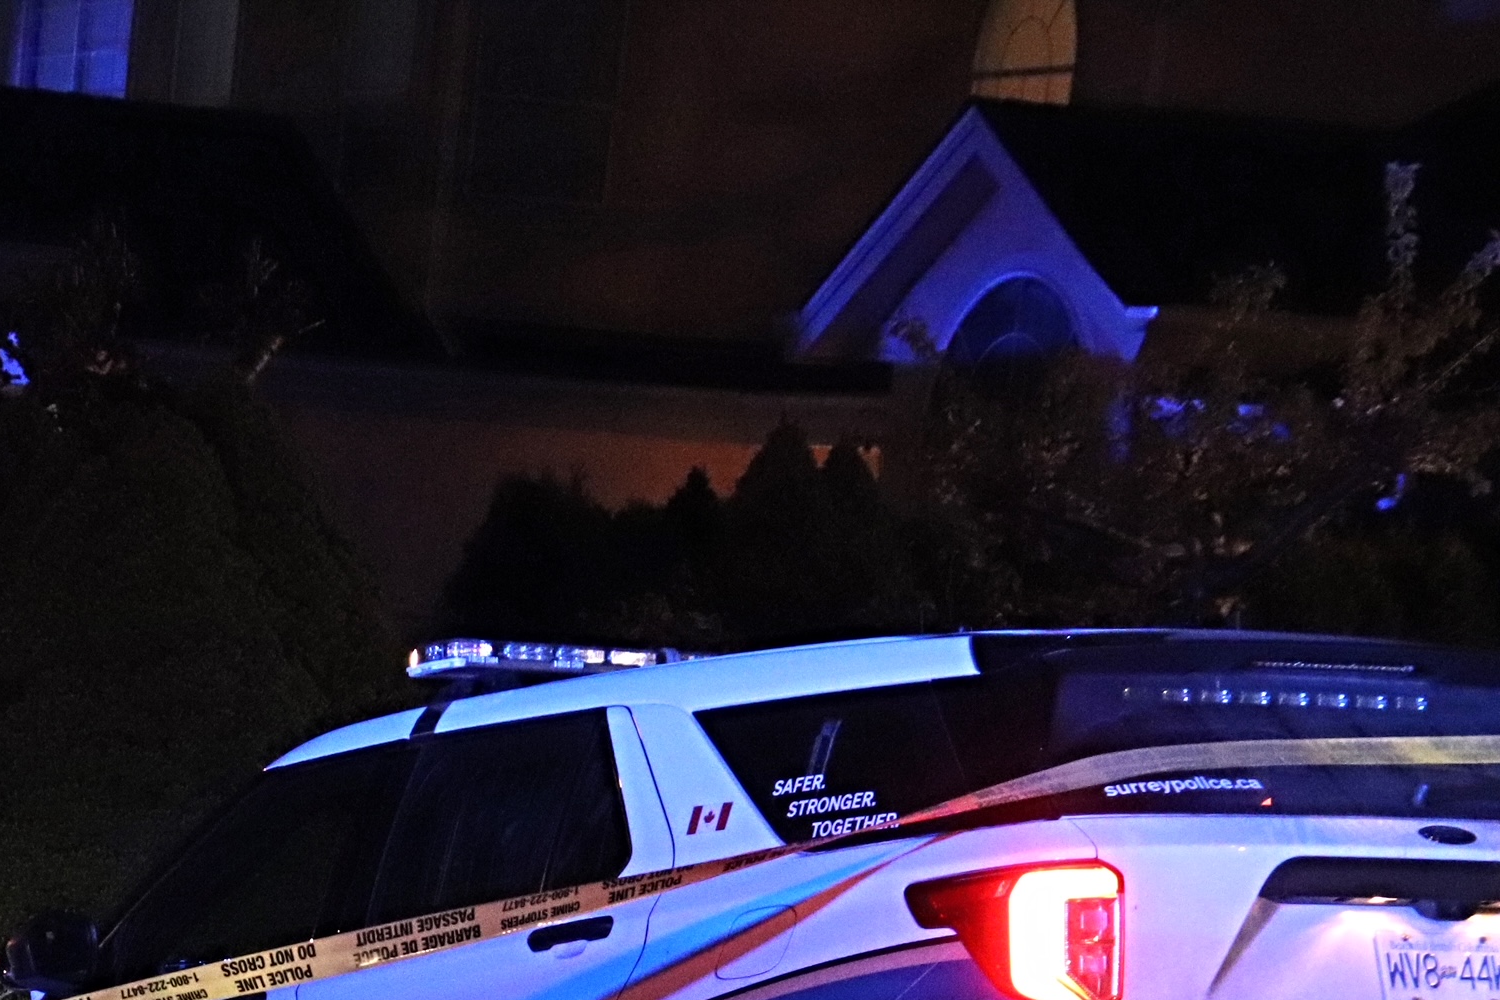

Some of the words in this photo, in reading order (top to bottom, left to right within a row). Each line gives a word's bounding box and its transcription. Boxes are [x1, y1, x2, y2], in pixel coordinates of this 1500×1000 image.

[772, 774, 826, 796] SAFER.
[1104, 776, 1264, 797] surreypolice.ca
[786, 791, 877, 818] STRONGER.
[609, 886, 637, 905] LINE
[640, 875, 682, 896] POLICE
[551, 901, 581, 918] CRIME
[417, 908, 476, 934] PASSAGE
[500, 911, 549, 931] STOPPERS
[356, 921, 414, 947] INTERDIT
[421, 924, 481, 951] BARRAGE
[269, 948, 296, 967] NOT
[297, 943, 317, 961] DO
[400, 940, 418, 956] DE
[220, 955, 266, 978] CROSS
[266, 963, 314, 986] POLICE
[120, 972, 200, 1000] 1-800-222-8477
[233, 975, 267, 993] LINE
